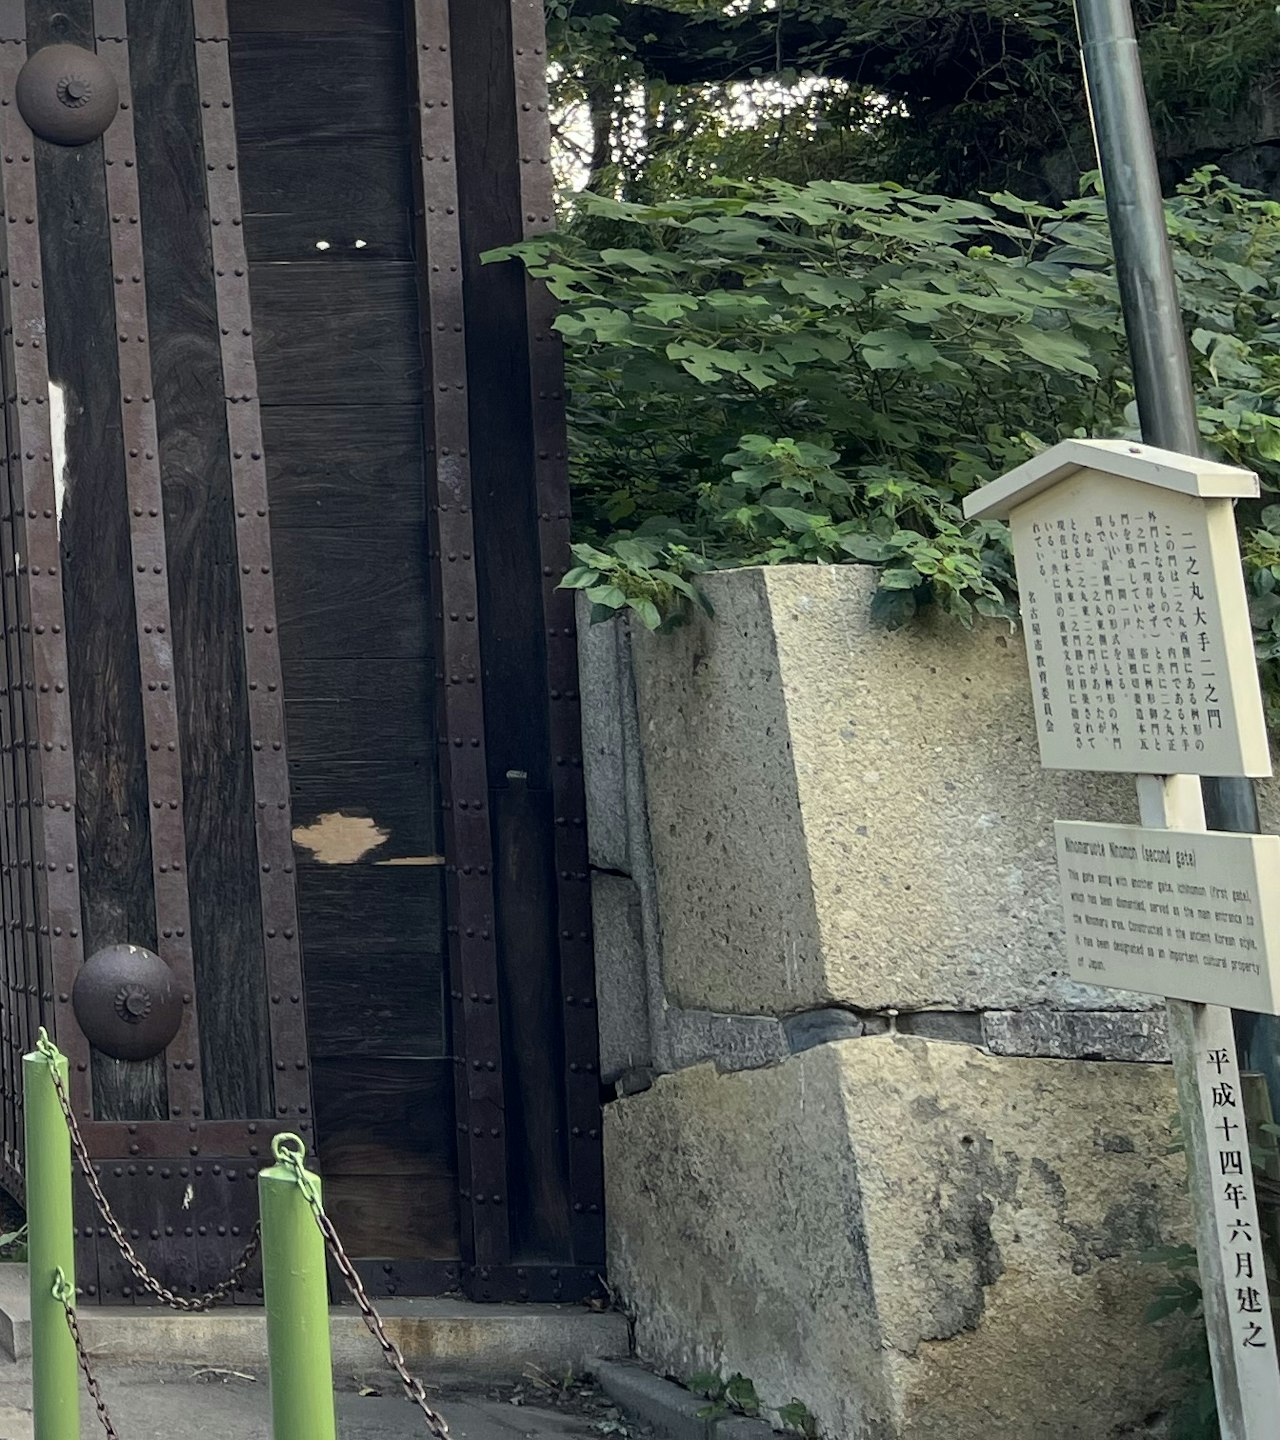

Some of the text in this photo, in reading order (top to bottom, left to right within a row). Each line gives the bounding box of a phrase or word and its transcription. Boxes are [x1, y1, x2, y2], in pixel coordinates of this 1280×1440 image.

[1182, 531, 1222, 729] 二之丸大手二之門
[1028, 592, 1054, 733] 名古屋市教育委員会
[1109, 842, 1138, 860] Ninomon
[1142, 845, 1170, 864] (second
[1176, 848, 1196, 869] gate)
[1068, 869, 1079, 881] This
[1082, 872, 1094, 883] gate
[1098, 874, 1112, 887] along
[1116, 876, 1127, 886] with
[1132, 878, 1153, 890] another
[1210, 885, 1228, 900] (first
[1088, 893, 1097, 905] has
[1101, 895, 1112, 906] been
[1150, 903, 1169, 915] served
[1173, 906, 1179, 916] as
[1184, 906, 1194, 918] the
[1215, 911, 1242, 924] entrance
[1247, 916, 1254, 926] to
[1176, 927, 1185, 939] the
[1078, 957, 1084, 967] of
[1084, 936, 1093, 947] has
[1097, 938, 1109, 950] been
[1231, 960, 1260, 975] property
[1206, 1047, 1267, 1349] 平成十四年六月建之
